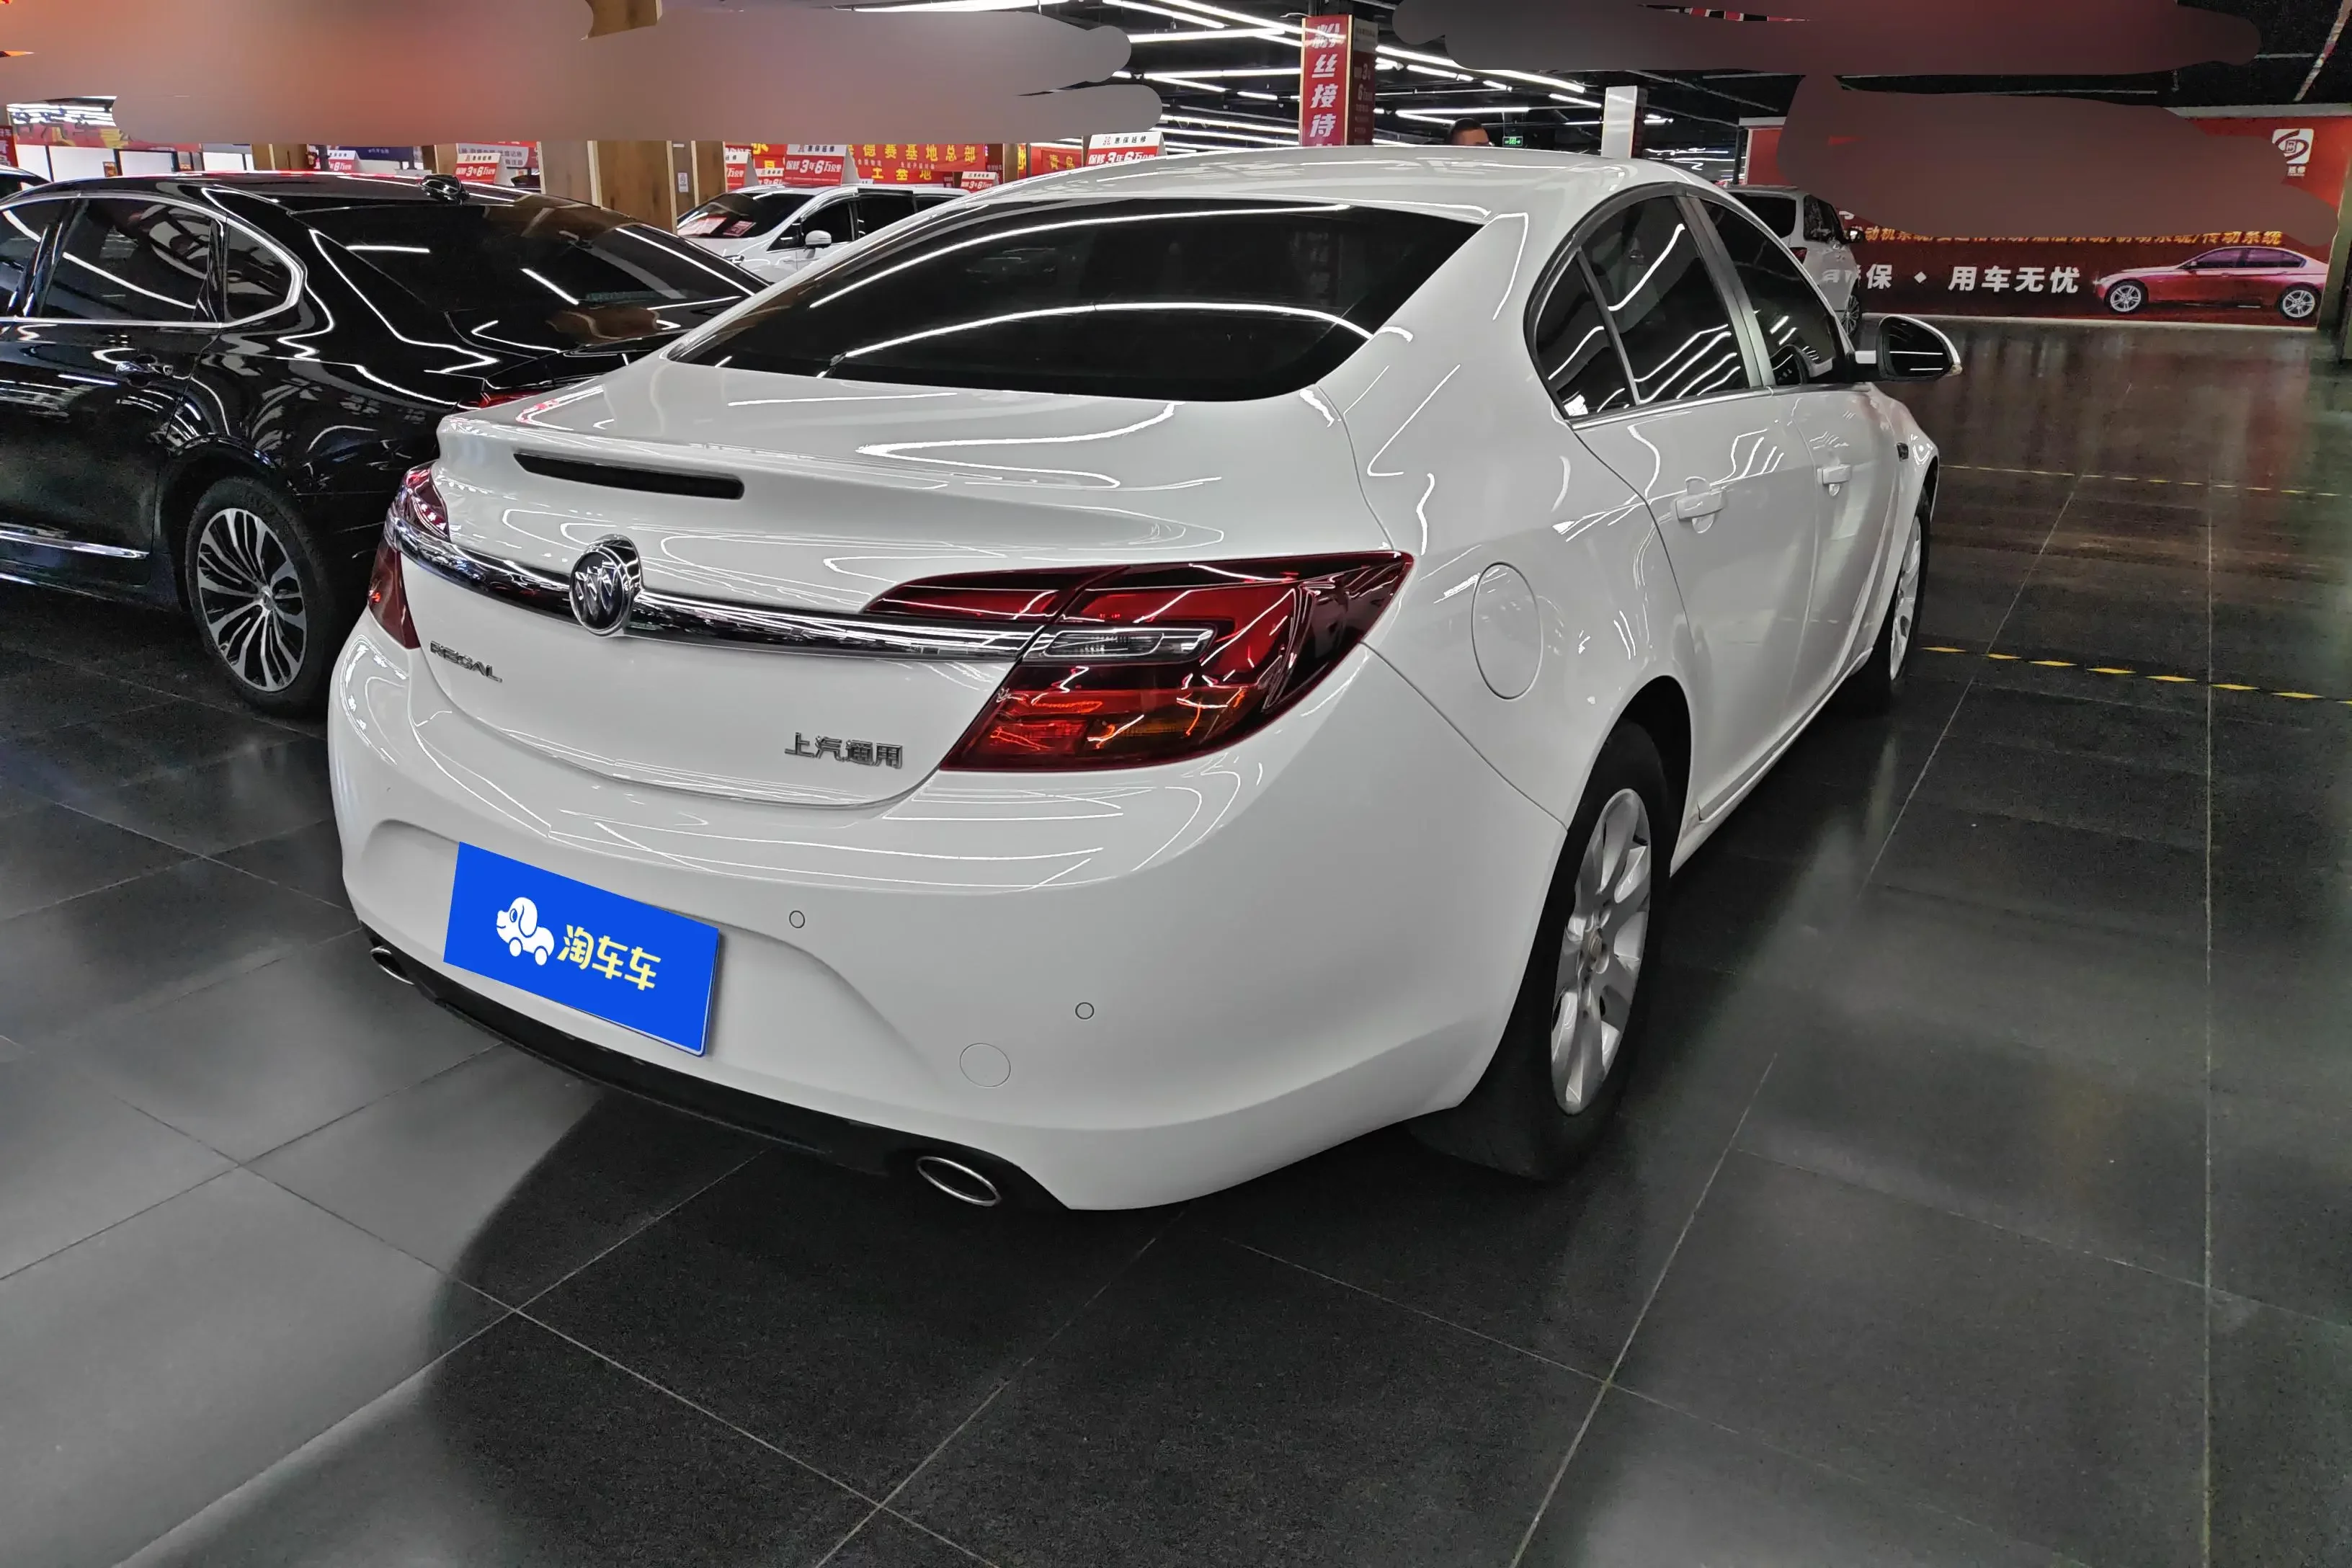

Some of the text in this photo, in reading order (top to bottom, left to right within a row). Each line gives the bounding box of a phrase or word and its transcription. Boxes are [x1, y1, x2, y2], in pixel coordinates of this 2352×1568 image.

[1309, 23, 1341, 146] 粉丝接待
[1858, 264, 2080, 293] 保 用车无忧
[430, 641, 503, 683] REGAL
[784, 731, 903, 769] 上汽通用
